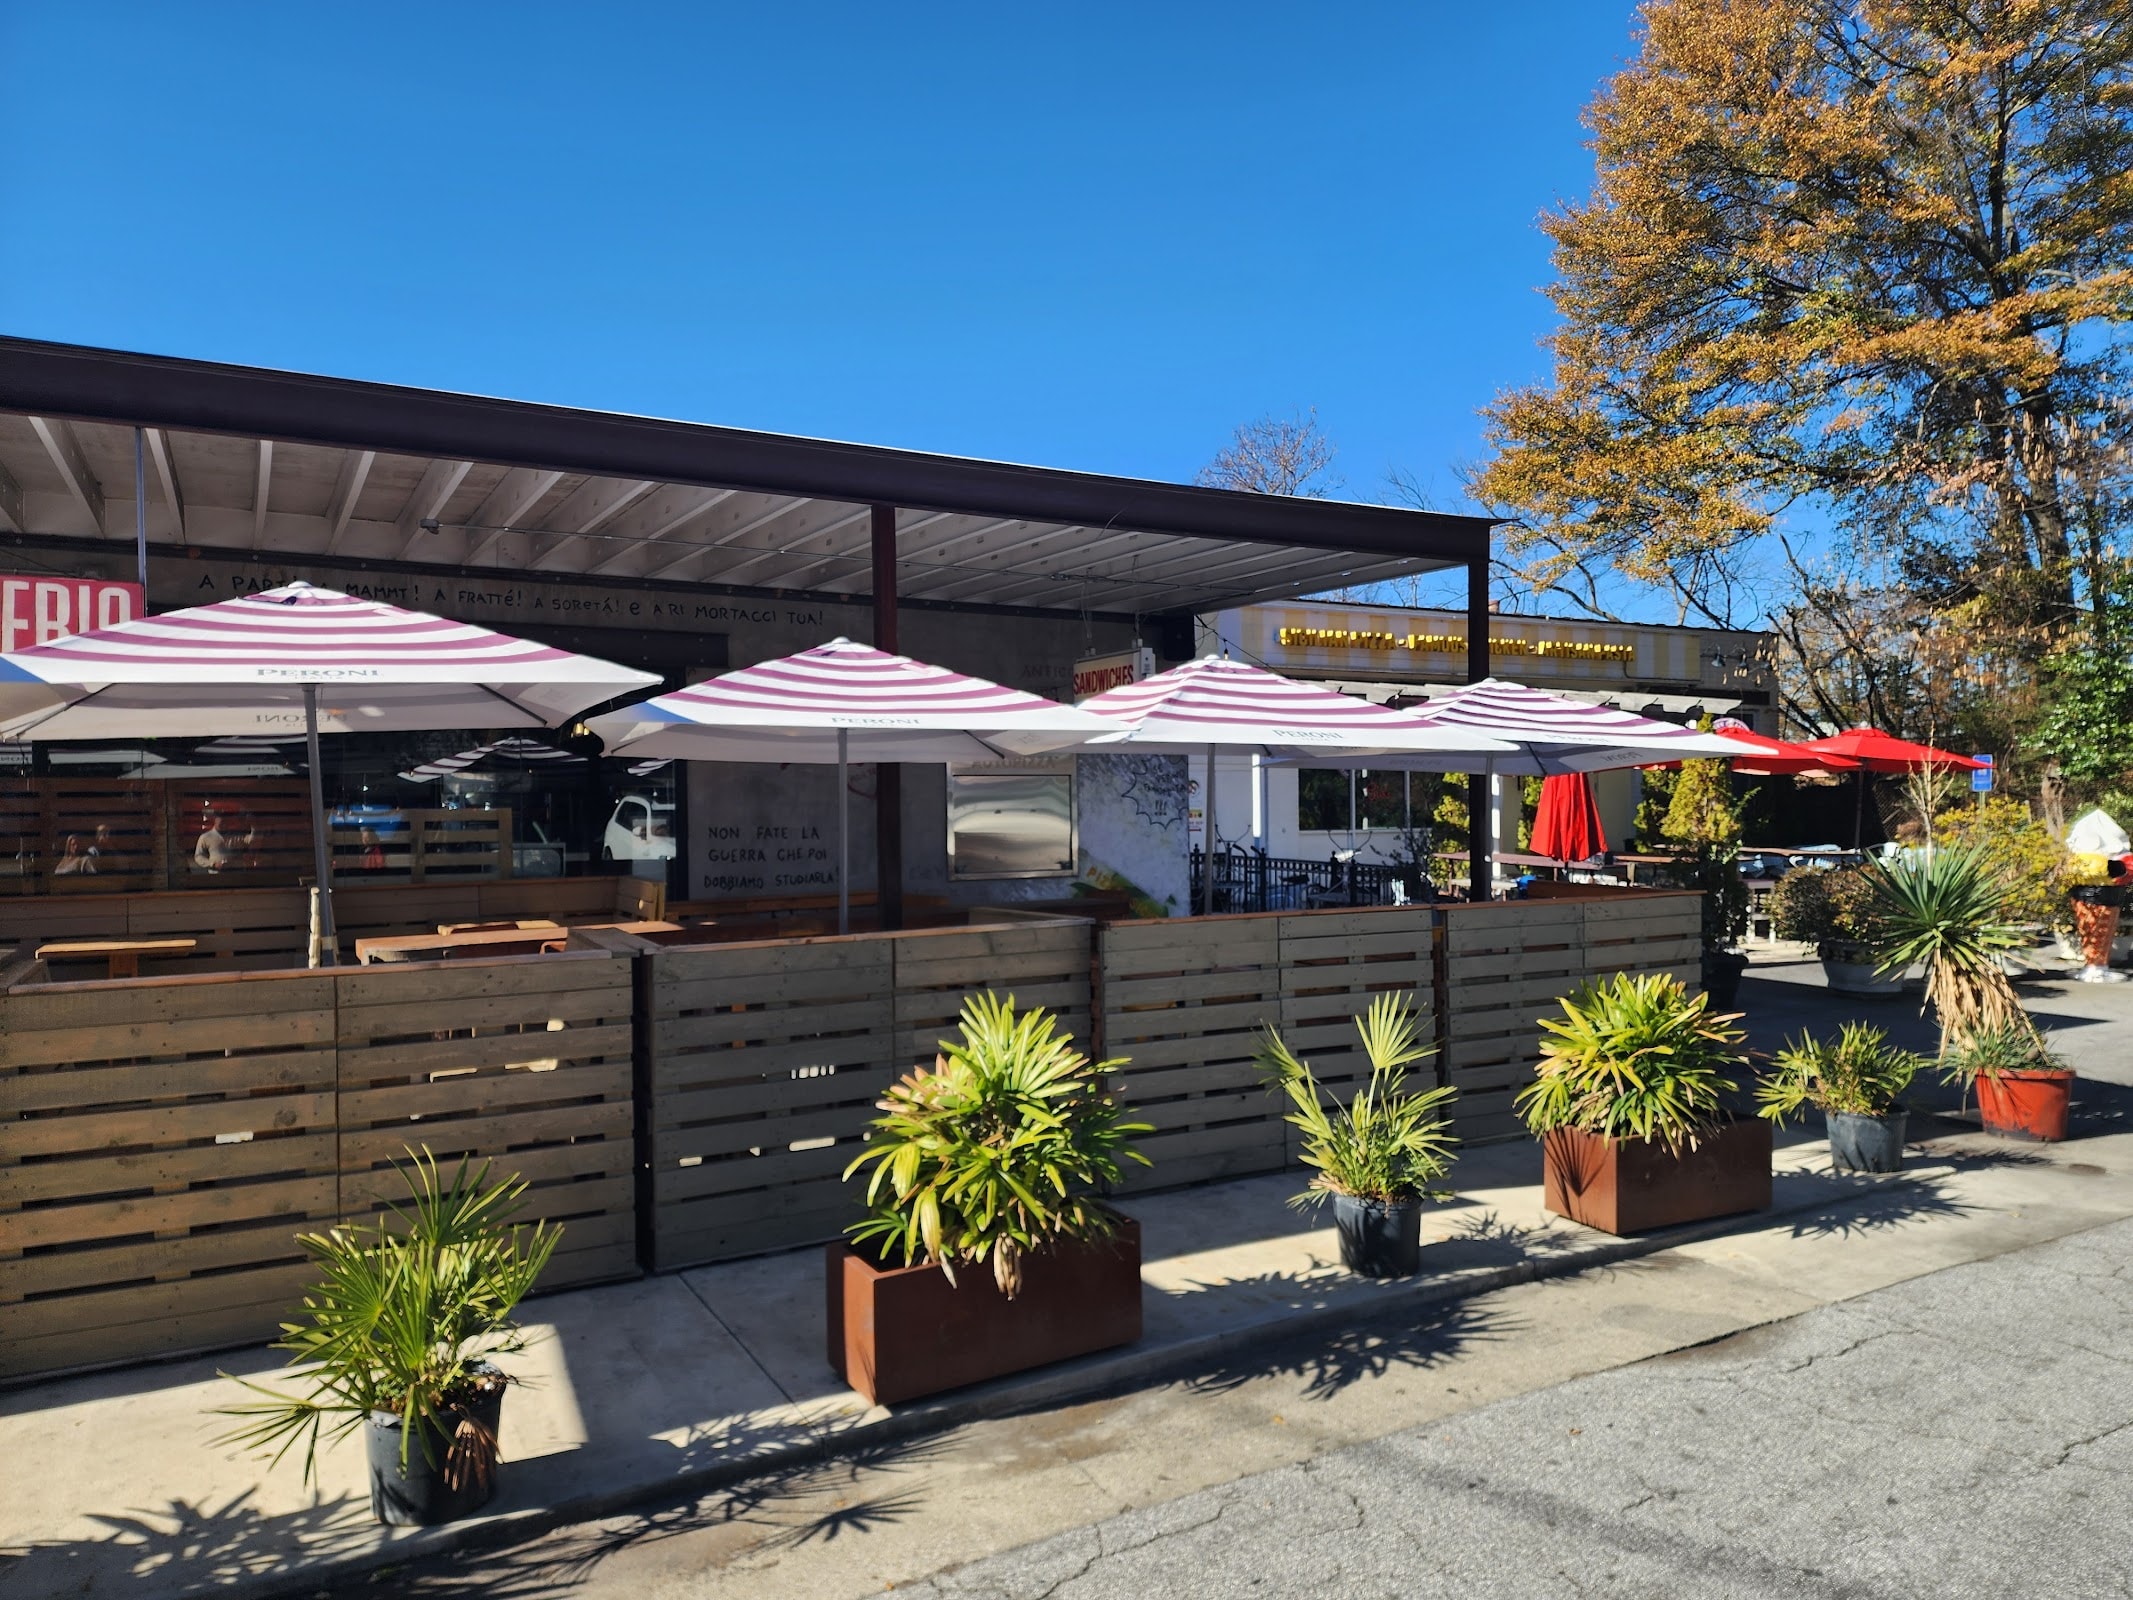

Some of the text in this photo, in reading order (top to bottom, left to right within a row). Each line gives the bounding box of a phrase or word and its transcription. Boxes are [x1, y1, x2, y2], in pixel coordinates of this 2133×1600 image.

[199, 574, 215, 590] A
[434, 589, 446, 601] A
[534, 598, 543, 609] A
[695, 606, 776, 622] MORTACCI
[787, 610, 823, 626] TUA!
[1350, 631, 1396, 650] PIZZA
[1407, 633, 1468, 652] FAMOUS
[1488, 637, 1528, 656] ICKEN
[1594, 644, 1634, 662] PASTA
[257, 669, 379, 677] PERONI
[1073, 664, 1134, 696] SANDWICHES
[831, 717, 920, 725] PERONI
[1272, 728, 1344, 740] PERONI
[708, 826, 820, 840] NON FATE LA
[708, 848, 827, 863] GUERRA CHE POI
